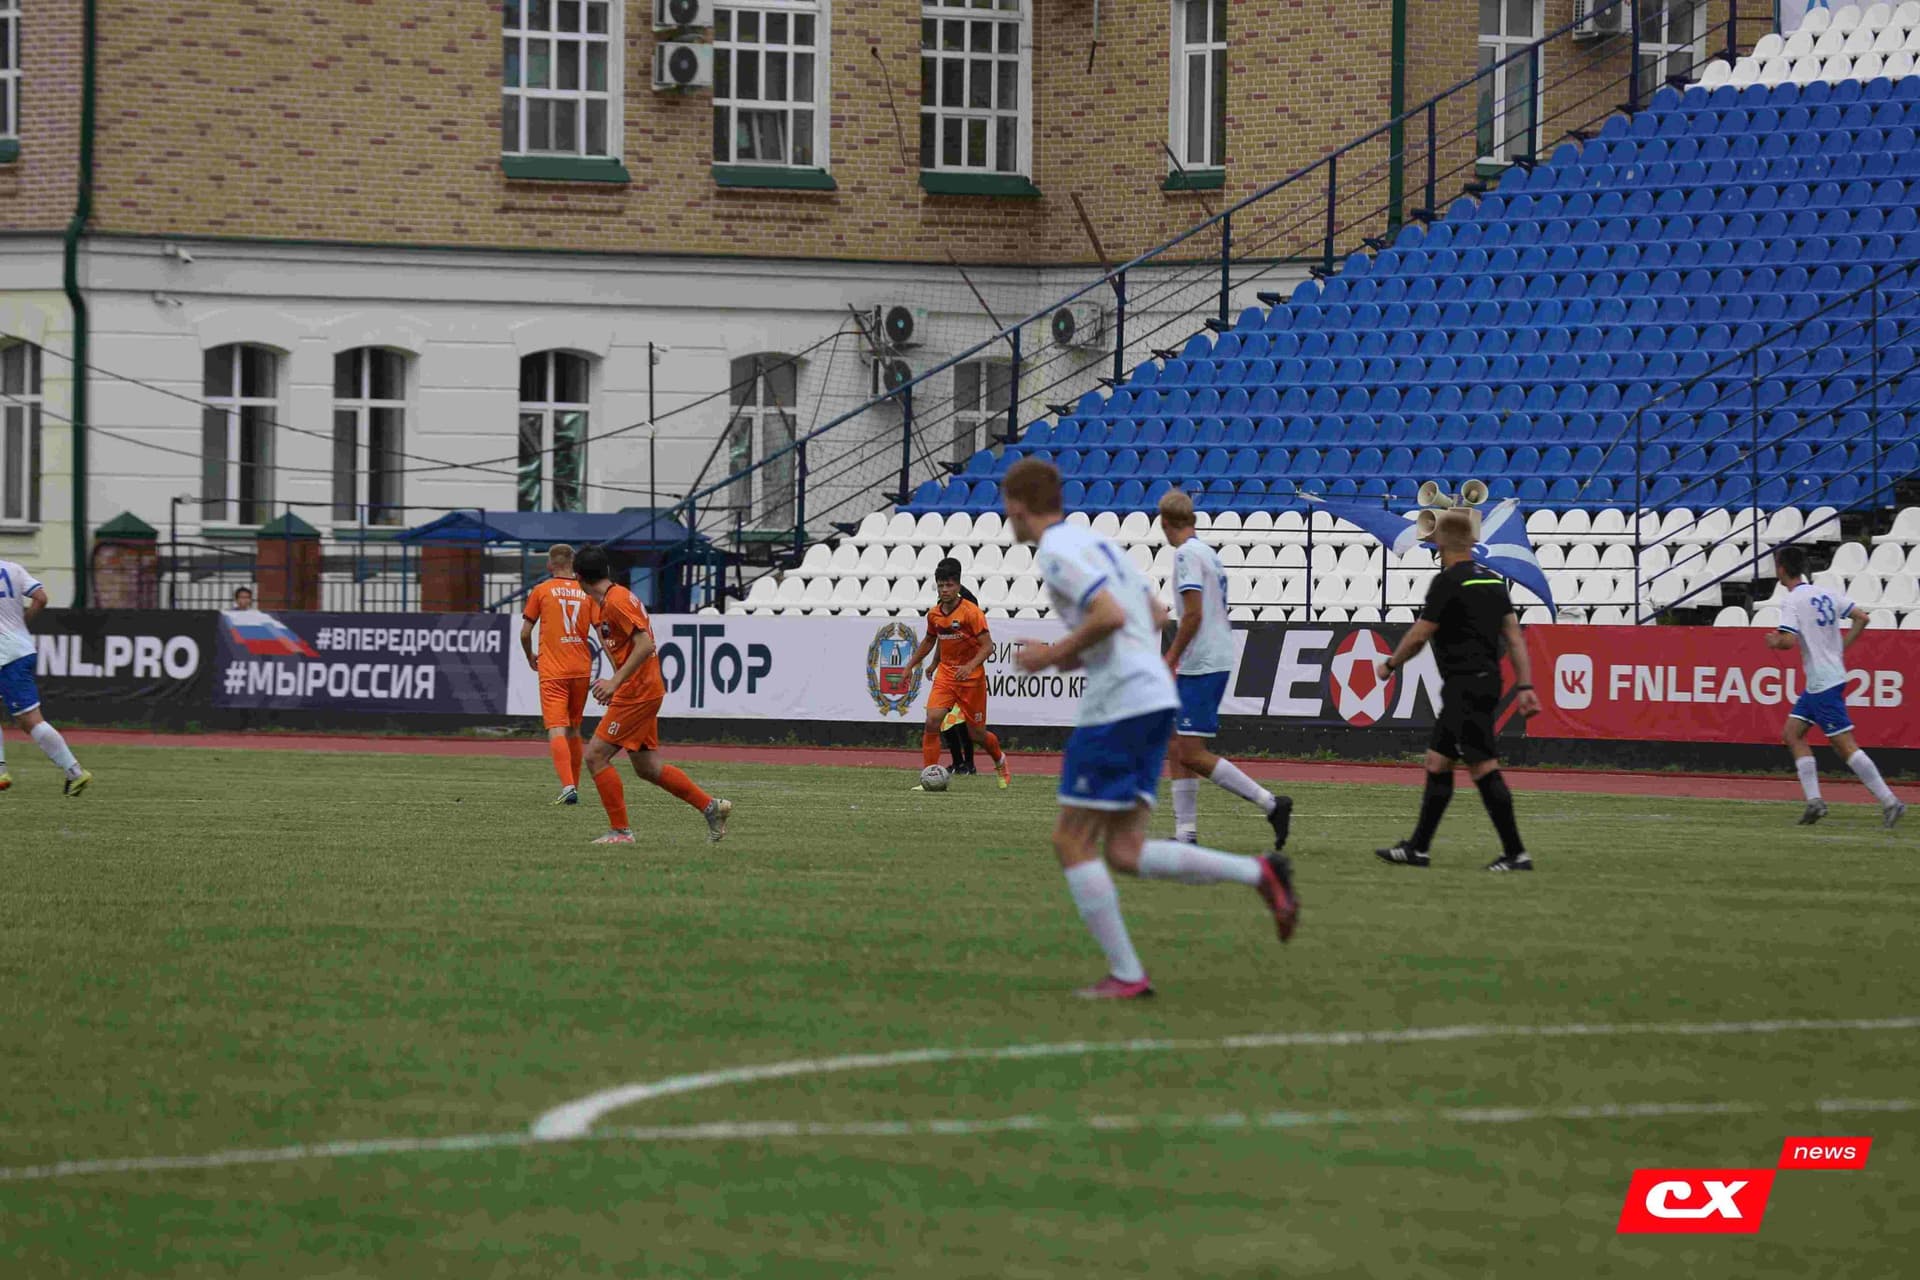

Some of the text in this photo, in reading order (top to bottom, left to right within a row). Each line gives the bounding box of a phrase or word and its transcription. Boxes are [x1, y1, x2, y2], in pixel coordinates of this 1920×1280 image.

[558, 598, 581, 635] 17
[1810, 595, 1837, 628] 33
[33, 634, 200, 680] NL.PRO
[316, 627, 502, 656] #ВПЕРЕДРОССИЯ
[223, 660, 436, 700] #МЫРОССИЯ
[658, 624, 773, 709] ОТОР
[1608, 663, 1904, 708] FNLEAGU2B
